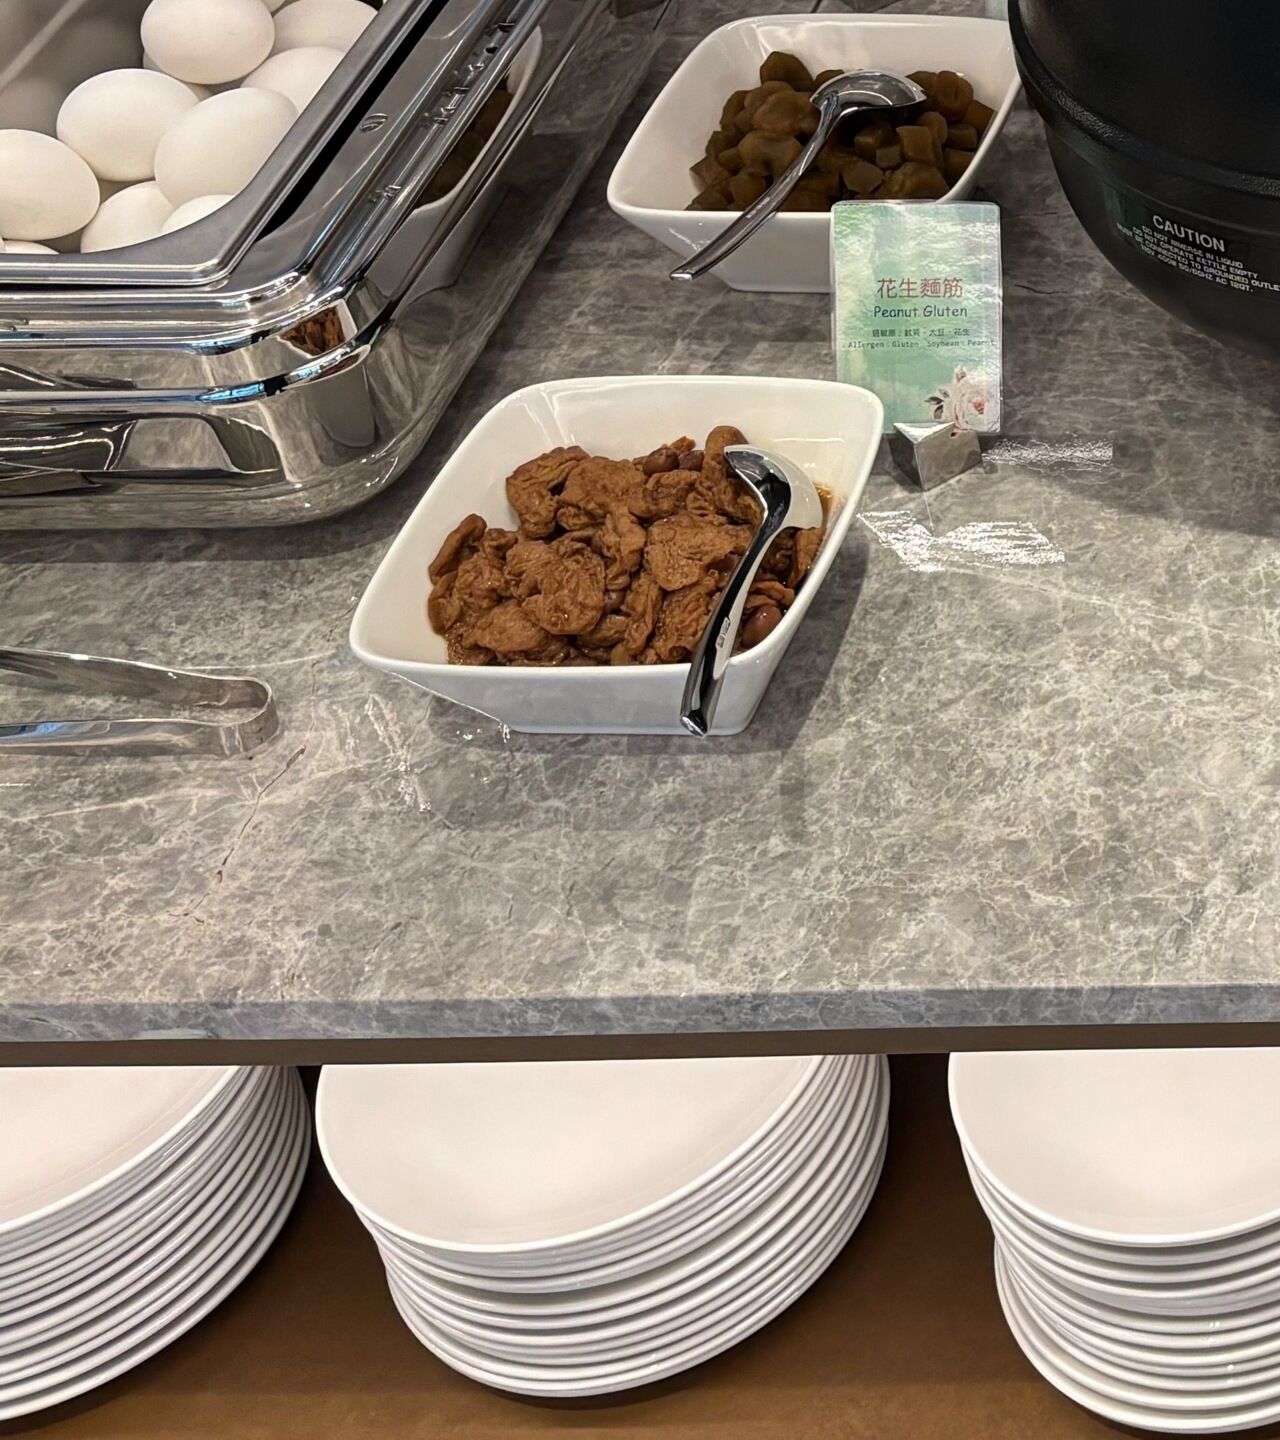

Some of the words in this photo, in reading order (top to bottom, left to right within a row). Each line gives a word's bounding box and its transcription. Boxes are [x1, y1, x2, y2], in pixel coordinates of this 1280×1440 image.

[1152, 215, 1225, 252] CAUTION
[877, 277, 963, 299] 花生麵筋
[874, 305, 918, 318] Peanut
[923, 305, 968, 318] Gluten
